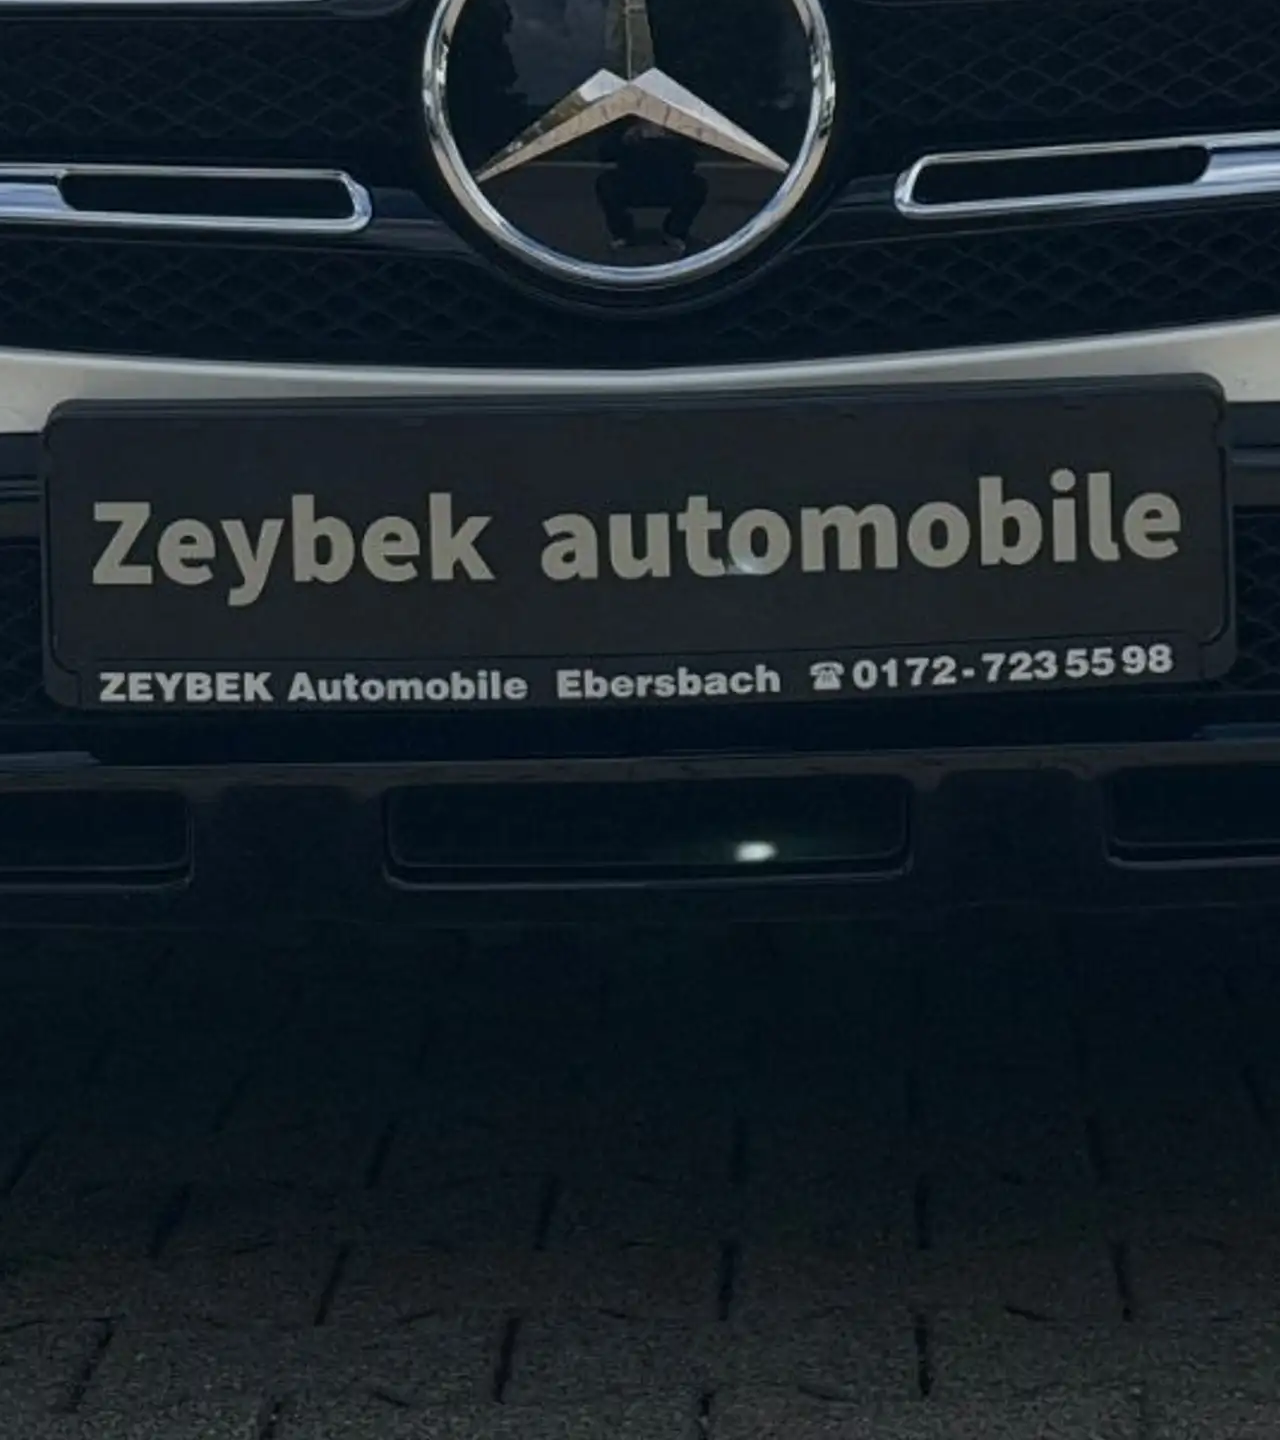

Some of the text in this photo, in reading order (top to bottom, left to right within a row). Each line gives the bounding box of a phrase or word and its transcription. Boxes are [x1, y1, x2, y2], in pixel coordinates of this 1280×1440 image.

[92, 468, 1181, 606] Zeybek automobile
[99, 672, 274, 702] ZEYBEK
[287, 670, 528, 702] Automobile
[557, 664, 781, 699] Ebersbach
